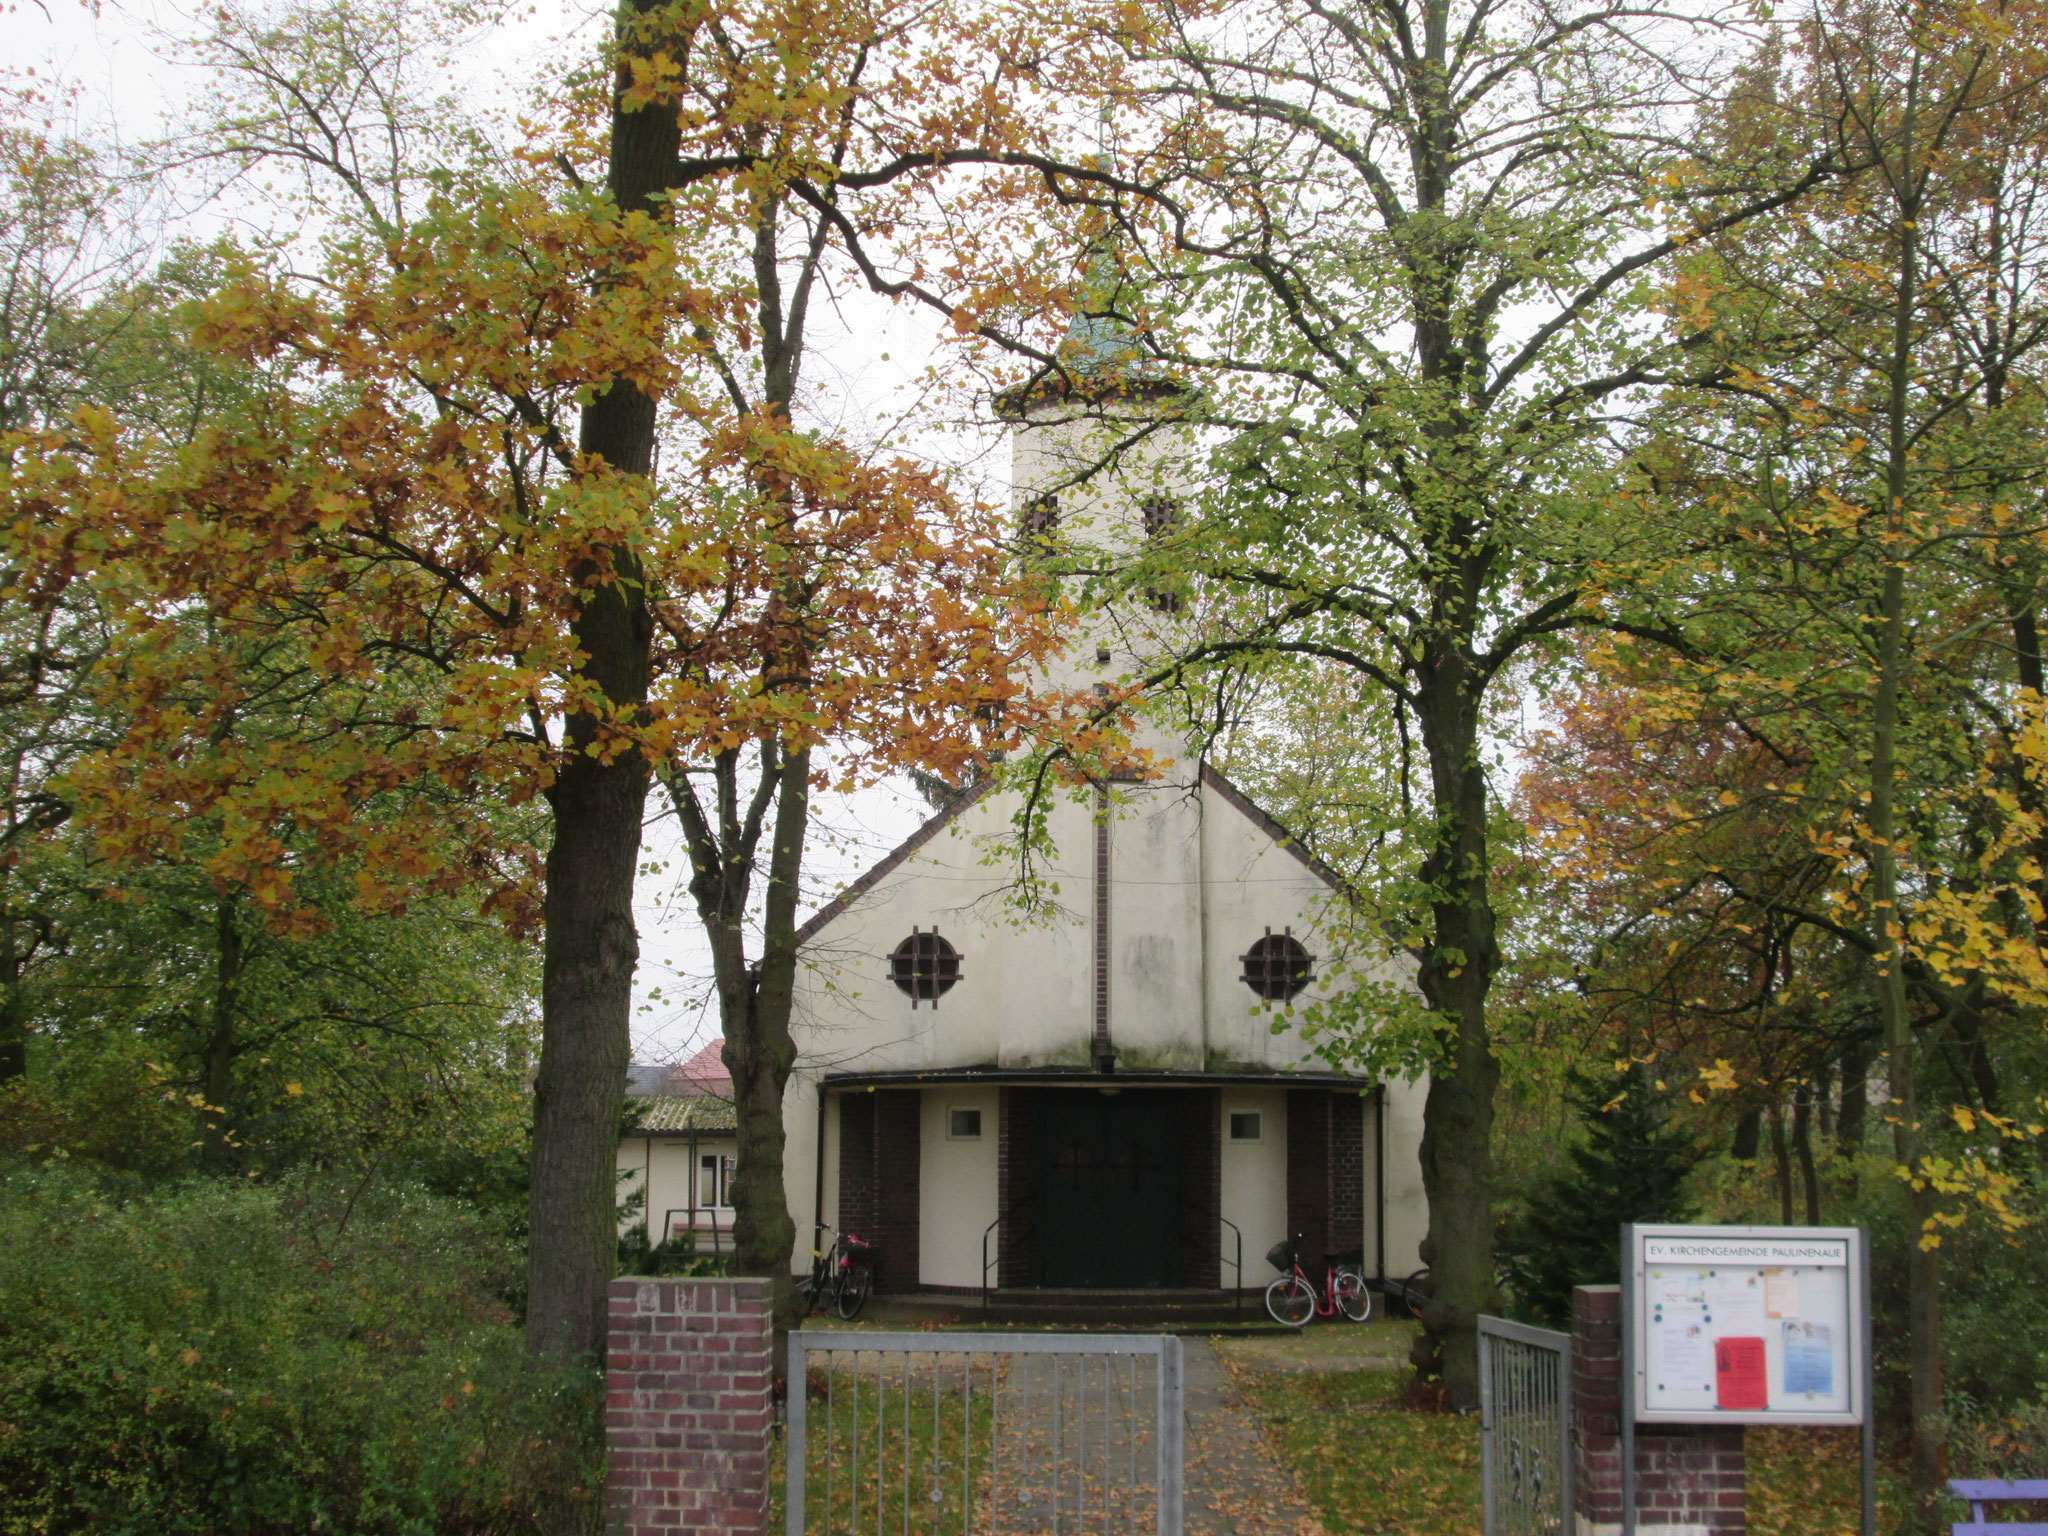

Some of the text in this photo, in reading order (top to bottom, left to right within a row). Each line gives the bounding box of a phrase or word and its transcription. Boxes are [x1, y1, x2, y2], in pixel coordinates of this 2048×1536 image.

[1651, 1246, 1841, 1258] EV. KIRCHENGEMEINDE PAULINENAUE
